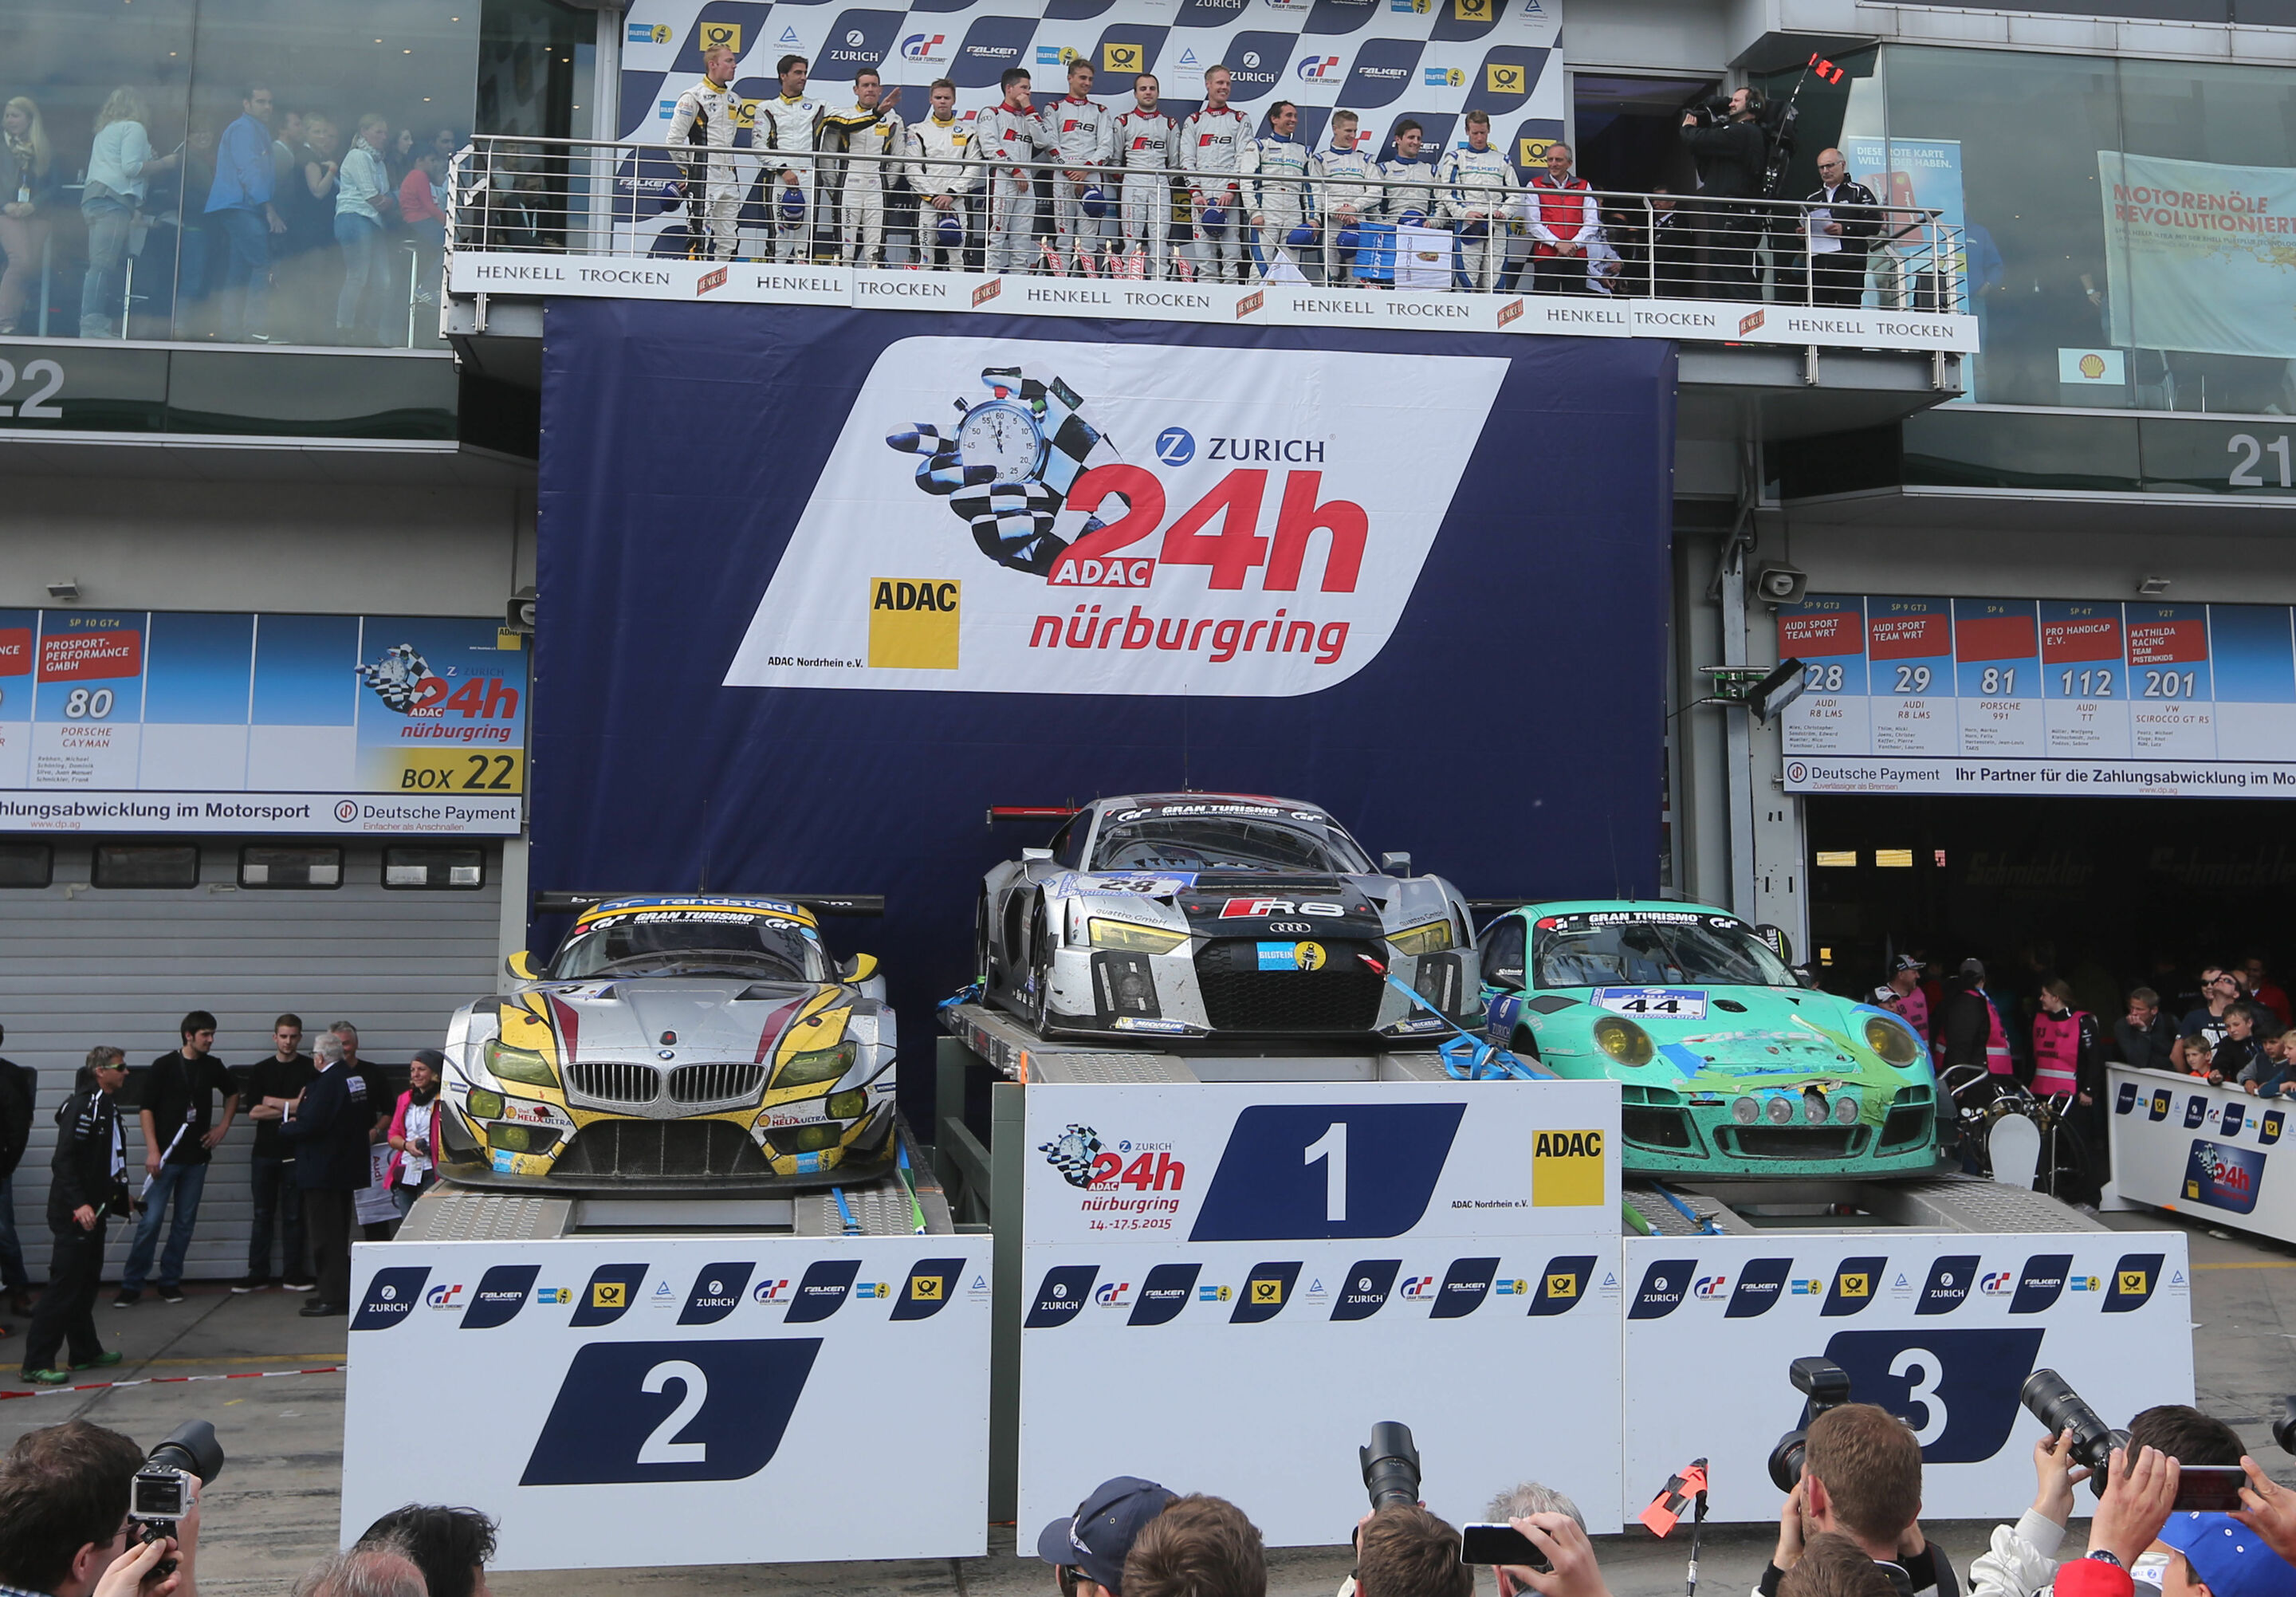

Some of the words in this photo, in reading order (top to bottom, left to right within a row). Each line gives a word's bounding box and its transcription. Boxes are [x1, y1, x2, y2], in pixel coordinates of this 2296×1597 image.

[1195, 0, 1241, 9] ZURICH
[831, 49, 879, 61] ZURICH
[966, 45, 1017, 55] FALKEN
[1230, 71, 1275, 83] ZURICH
[1358, 66, 1407, 77] FALKEN
[1070, 122, 1095, 132] R8
[1209, 136, 1233, 144] R8
[1857, 147, 1883, 156] DIESE
[1913, 149, 1944, 158] KARTE
[1858, 156, 1881, 165] WILL
[1914, 159, 1952, 168] HABEN.
[2113, 183, 2269, 214] MOTORENÖLE
[477, 266, 565, 281] HENKELL
[579, 269, 670, 285] TROCKEN
[757, 276, 843, 293] HENKELL
[858, 281, 946, 297] TROCKEN
[1028, 288, 1111, 305] HENKELL
[1125, 293, 1210, 308] TROCKEN
[1293, 299, 1374, 314] HENKELL
[1387, 302, 1469, 318] TROCKEN
[1547, 308, 1626, 324] HENKELL
[1634, 312, 1716, 327] TROCKEN
[1787, 318, 1865, 334] HENKELL
[1877, 322, 1954, 338] TROCKEN
[1208, 438, 1324, 462] ZURICH
[2227, 434, 2291, 487] 21
[1047, 463, 1369, 592] 24h
[1054, 560, 1149, 586] ADAC
[874, 582, 957, 612] ADAC
[69, 619, 81, 627] SP
[85, 619, 96, 627] 10
[1785, 621, 1807, 631] AUDI
[1810, 619, 1839, 629] SPORT
[1873, 623, 1894, 632] AUDI
[1897, 620, 1926, 631] SPORT
[1029, 604, 1350, 664] nürburgring
[1786, 631, 1812, 640] TEAM
[1815, 628, 1836, 638] WRT
[2046, 627, 2063, 636] PRO
[2066, 623, 2110, 635] HANDICAP
[2131, 627, 2176, 638] MATHILDA
[1874, 632, 1899, 642] TEAM
[1902, 630, 1923, 639] WRT
[2132, 637, 2164, 647] RACING
[45, 638, 110, 651] PROSPORT-
[45, 647, 130, 662] PERFORMANCE
[2133, 654, 2173, 663] PISTENKIDS
[46, 661, 80, 672] GMBH
[768, 656, 794, 667] ADAC
[797, 657, 843, 667] Nordrhein
[847, 659, 863, 668] e.V.
[464, 668, 505, 677] ZURICH
[1807, 664, 1843, 691] 28
[1894, 666, 1931, 693] 29
[1981, 667, 2015, 694] 81
[2062, 669, 2112, 697] 112
[2144, 671, 2194, 698] 201
[65, 688, 114, 719] 80
[408, 677, 519, 718] 24h
[1815, 699, 1837, 708] AUDI
[410, 707, 443, 717] ADAC
[1980, 702, 2021, 711] PORSCHE
[1810, 709, 1822, 718] R8
[1825, 710, 1843, 718] LMS
[1898, 710, 1910, 719] R8
[2136, 714, 2180, 723] SCIROCCO
[2183, 715, 2196, 724] GT
[61, 726, 113, 738] PORSCHE
[401, 722, 511, 742] nürburgring
[62, 738, 111, 748] CAYMAN
[401, 769, 454, 789] BOX
[462, 755, 514, 789] 22
[1812, 767, 1876, 781] Deutsche
[1881, 768, 1940, 785] Payment
[1956, 767, 1976, 781] Ihr
[1980, 768, 2036, 782] Partner
[2040, 768, 2062, 782] für
[2066, 769, 2088, 783] die
[2093, 769, 2246, 787] Zahlungsabwicklung
[2251, 771, 2269, 785] im
[2139, 785, 2178, 794] www.dp.ag
[177, 802, 199, 817] im
[206, 803, 310, 821] Motorsport
[364, 805, 441, 820] Deutsche
[446, 806, 516, 824] Payment
[1162, 805, 1205, 814] GRAN
[1210, 805, 1279, 815] TURISMO
[31, 820, 81, 830] www.dp.ag
[1099, 879, 1157, 893] 28
[660, 898, 793, 914] randstad
[1248, 900, 1345, 917] R8
[635, 911, 678, 922] GRAN
[685, 911, 755, 922] TURISMO
[1134, 914, 1168, 926] GmbH
[1589, 913, 1630, 922] GRAN
[1634, 912, 1699, 922] TURISMO
[1260, 950, 1294, 960] BILSTEIN
[1622, 999, 1681, 1013] 44
[1135, 1021, 1184, 1032] MICHELIN
[1411, 1020, 1441, 1029] MICHELIN
[1492, 1022, 1512, 1036] ZURICH
[518, 1114, 544, 1123] HELIX
[545, 1116, 572, 1127] ULTRA
[773, 1118, 799, 1127] HELIX
[1535, 1132, 1602, 1158] ADAC
[1087, 1152, 1185, 1191] 24h
[1305, 1123, 1347, 1221] 1
[2214, 1162, 2251, 1190] 24h
[1088, 1182, 1119, 1191] ADAC
[1081, 1196, 1180, 1213] nürburgring
[1451, 1200, 1472, 1209] ADAC
[1475, 1199, 1512, 1209] Nordrhein
[1515, 1199, 1528, 1208] e.V.
[1089, 1218, 1172, 1231] 14.-17.5.2015
[1347, 1294, 1384, 1304] ZURICH
[1643, 1294, 1679, 1303] ZURICH
[1931, 1289, 1964, 1298] ZURICH
[369, 1303, 408, 1312] ZURICH
[696, 1297, 734, 1307] ZURICH
[1041, 1300, 1079, 1311] ZURICH
[1888, 1348, 1948, 1447] 3
[636, 1359, 708, 1464] 2
